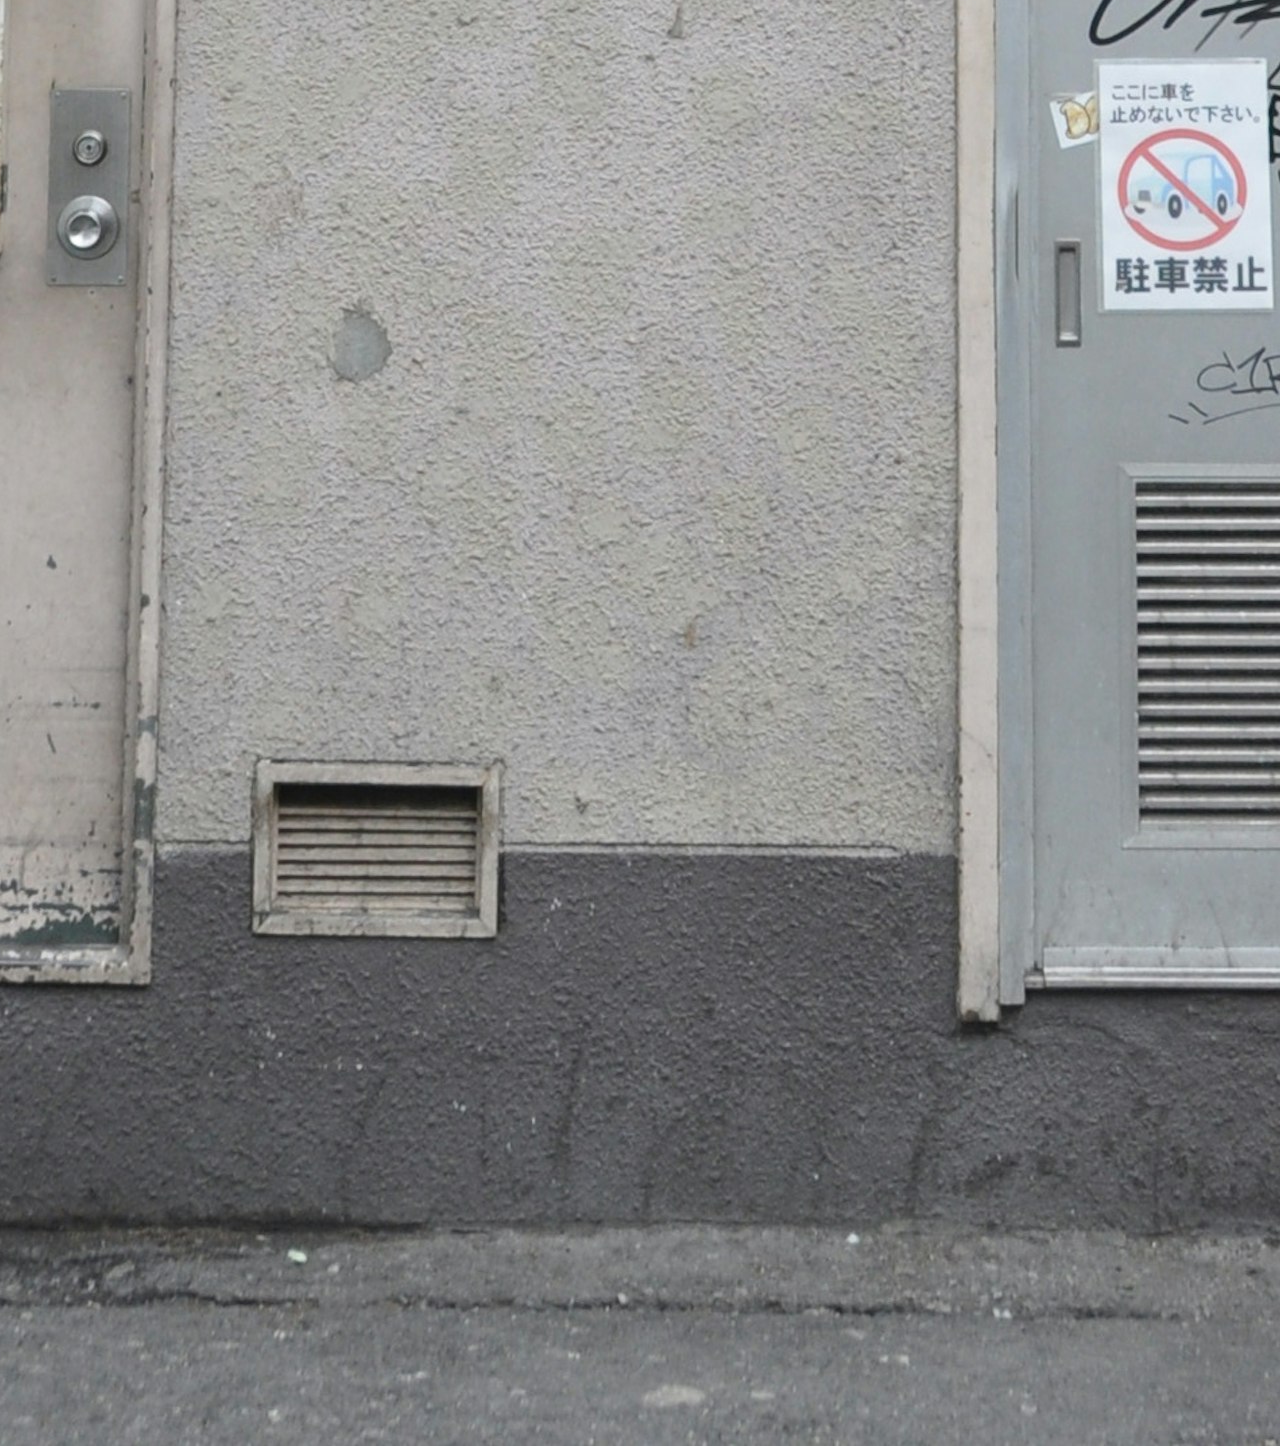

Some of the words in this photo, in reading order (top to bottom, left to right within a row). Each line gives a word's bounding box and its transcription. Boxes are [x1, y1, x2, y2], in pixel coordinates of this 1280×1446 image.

[1111, 83, 1195, 102] ここに車を
[1109, 104, 1261, 125] 止めないで下さい。
[1115, 256, 1268, 294] 駐車禁止
